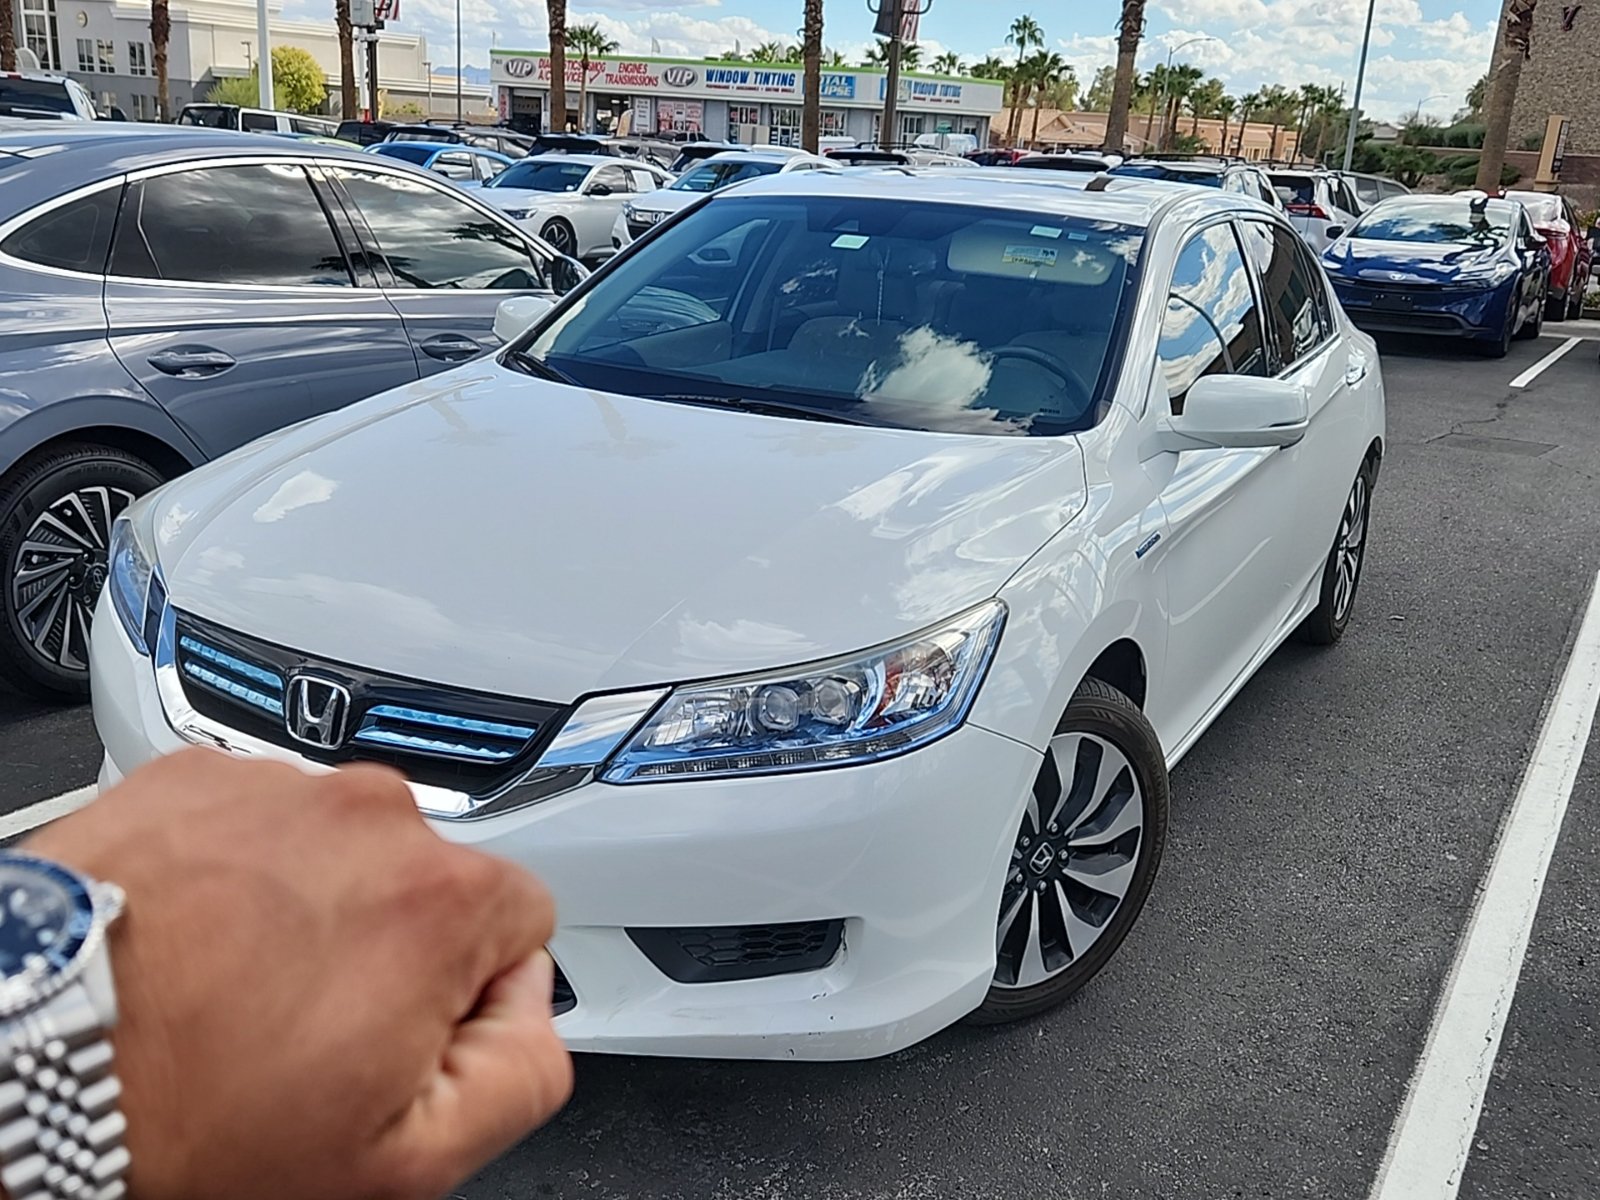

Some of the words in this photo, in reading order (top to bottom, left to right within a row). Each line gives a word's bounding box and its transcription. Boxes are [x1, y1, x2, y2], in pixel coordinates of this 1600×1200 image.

[508, 61, 532, 74] VIP
[618, 62, 648, 75] ENGINES
[605, 73, 659, 87] TRANSMISSIONS
[666, 69, 694, 84] VIP
[705, 69, 750, 84] WINDOW
[754, 71, 796, 87] TINTING
